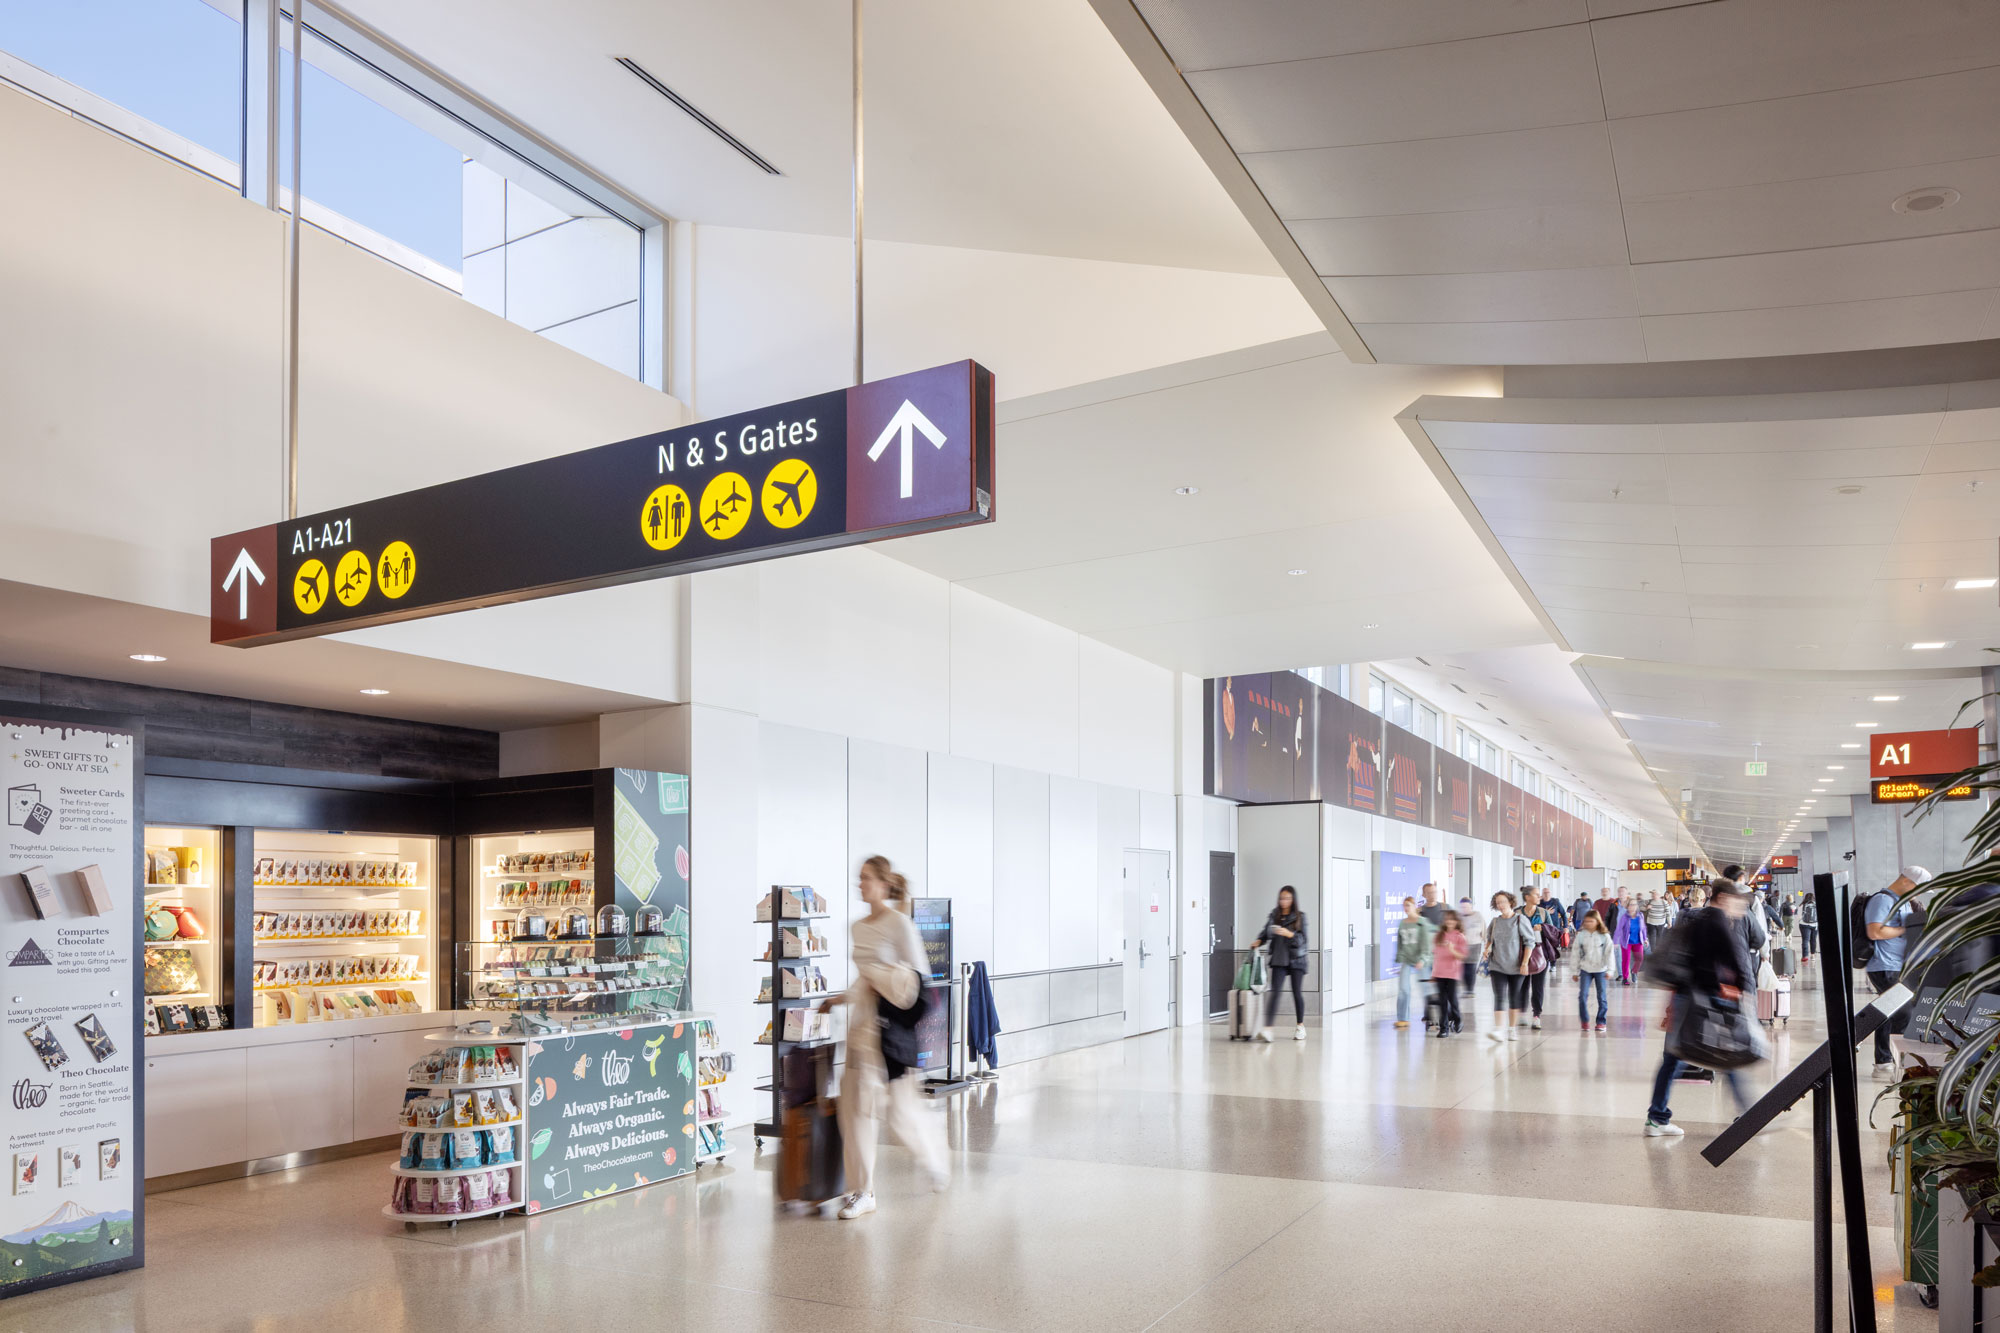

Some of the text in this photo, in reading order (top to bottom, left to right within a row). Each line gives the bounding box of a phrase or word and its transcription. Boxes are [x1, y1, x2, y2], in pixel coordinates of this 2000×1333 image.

[658, 418, 818, 474] N & S Gates
[292, 518, 352, 555] A1-A21
[24, 748, 109, 764] SWEET GIFTS TO
[1879, 743, 1911, 766] A1
[47, 761, 74, 772] ONLY
[75, 763, 88, 772] AT
[90, 764, 109, 774] SEA
[60, 786, 125, 798] Sweeter Cards
[1879, 783, 1919, 792] Atlanta
[1879, 790, 1914, 798] Korean
[60, 798, 110, 808] The first-ever
[59, 808, 91, 817] greeting
[92, 808, 109, 816] card
[59, 816, 128, 825] gourmet chocolate
[80, 824, 89, 832] all
[9, 853, 22, 861] any
[57, 928, 110, 938] Compartes
[57, 936, 105, 946] Chocolate
[57, 950, 74, 958] Take
[80, 950, 97, 958] taste
[98, 949, 106, 957] of
[87, 958, 108, 967] Gifting
[56, 967, 80, 975] looked
[80, 966, 92, 974] this
[1921, 997, 1933, 1005] NO
[7, 1008, 33, 1017] Luxury
[34, 1005, 70, 1014] chocolate
[71, 1002, 102, 1012] wrapped
[103, 1001, 110, 1009] in
[7, 1016, 30, 1025] made
[31, 1015, 39, 1023] to
[60, 1063, 130, 1079] Theo Chocolate
[601, 1049, 635, 1087] theo
[59, 1084, 78, 1092] Born
[59, 1086, 129, 1100] made for the world
[12, 1078, 54, 1110] theo
[98, 1096, 111, 1105] fair
[112, 1094, 131, 1103] trade
[562, 1086, 671, 1118] Always Fair Trade.
[59, 1107, 97, 1118] chocolate
[568, 1107, 665, 1138] Always Organic.
[9, 1120, 117, 1142] A sweet taste of the great Pacific
[9, 1139, 46, 1151] Northwest
[564, 1129, 669, 1161] Always Delicious.
[583, 1150, 654, 1174] TheoChocolate.com
